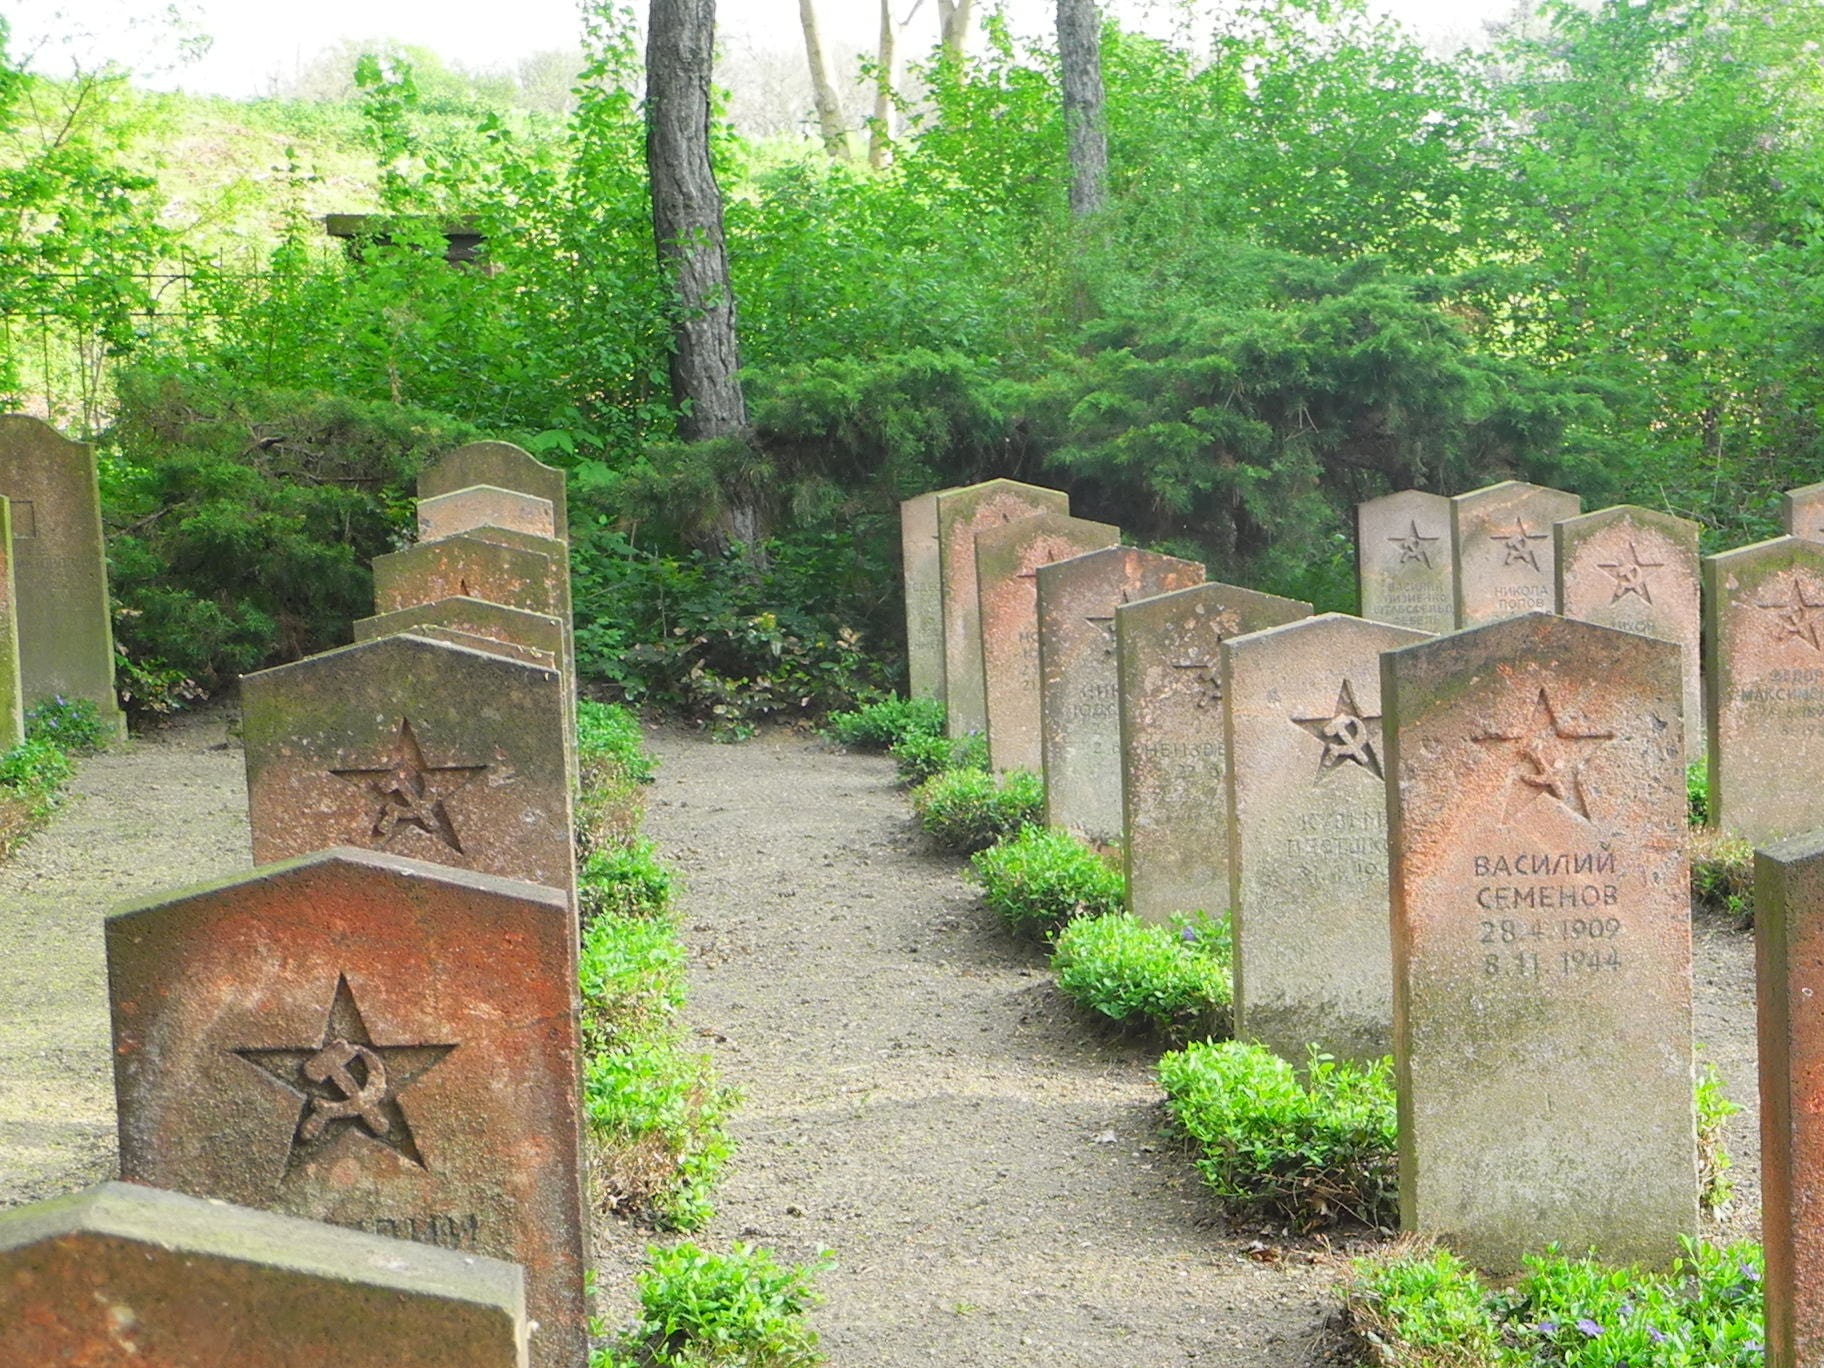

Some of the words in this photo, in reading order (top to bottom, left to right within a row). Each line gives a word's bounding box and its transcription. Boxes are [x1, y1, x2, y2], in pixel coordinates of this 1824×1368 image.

[1500, 599, 1545, 610] ПОПОВ
[1474, 840, 1617, 877] ВАСИЛИЙ
[1476, 884, 1618, 910] СЕМЕНОВ
